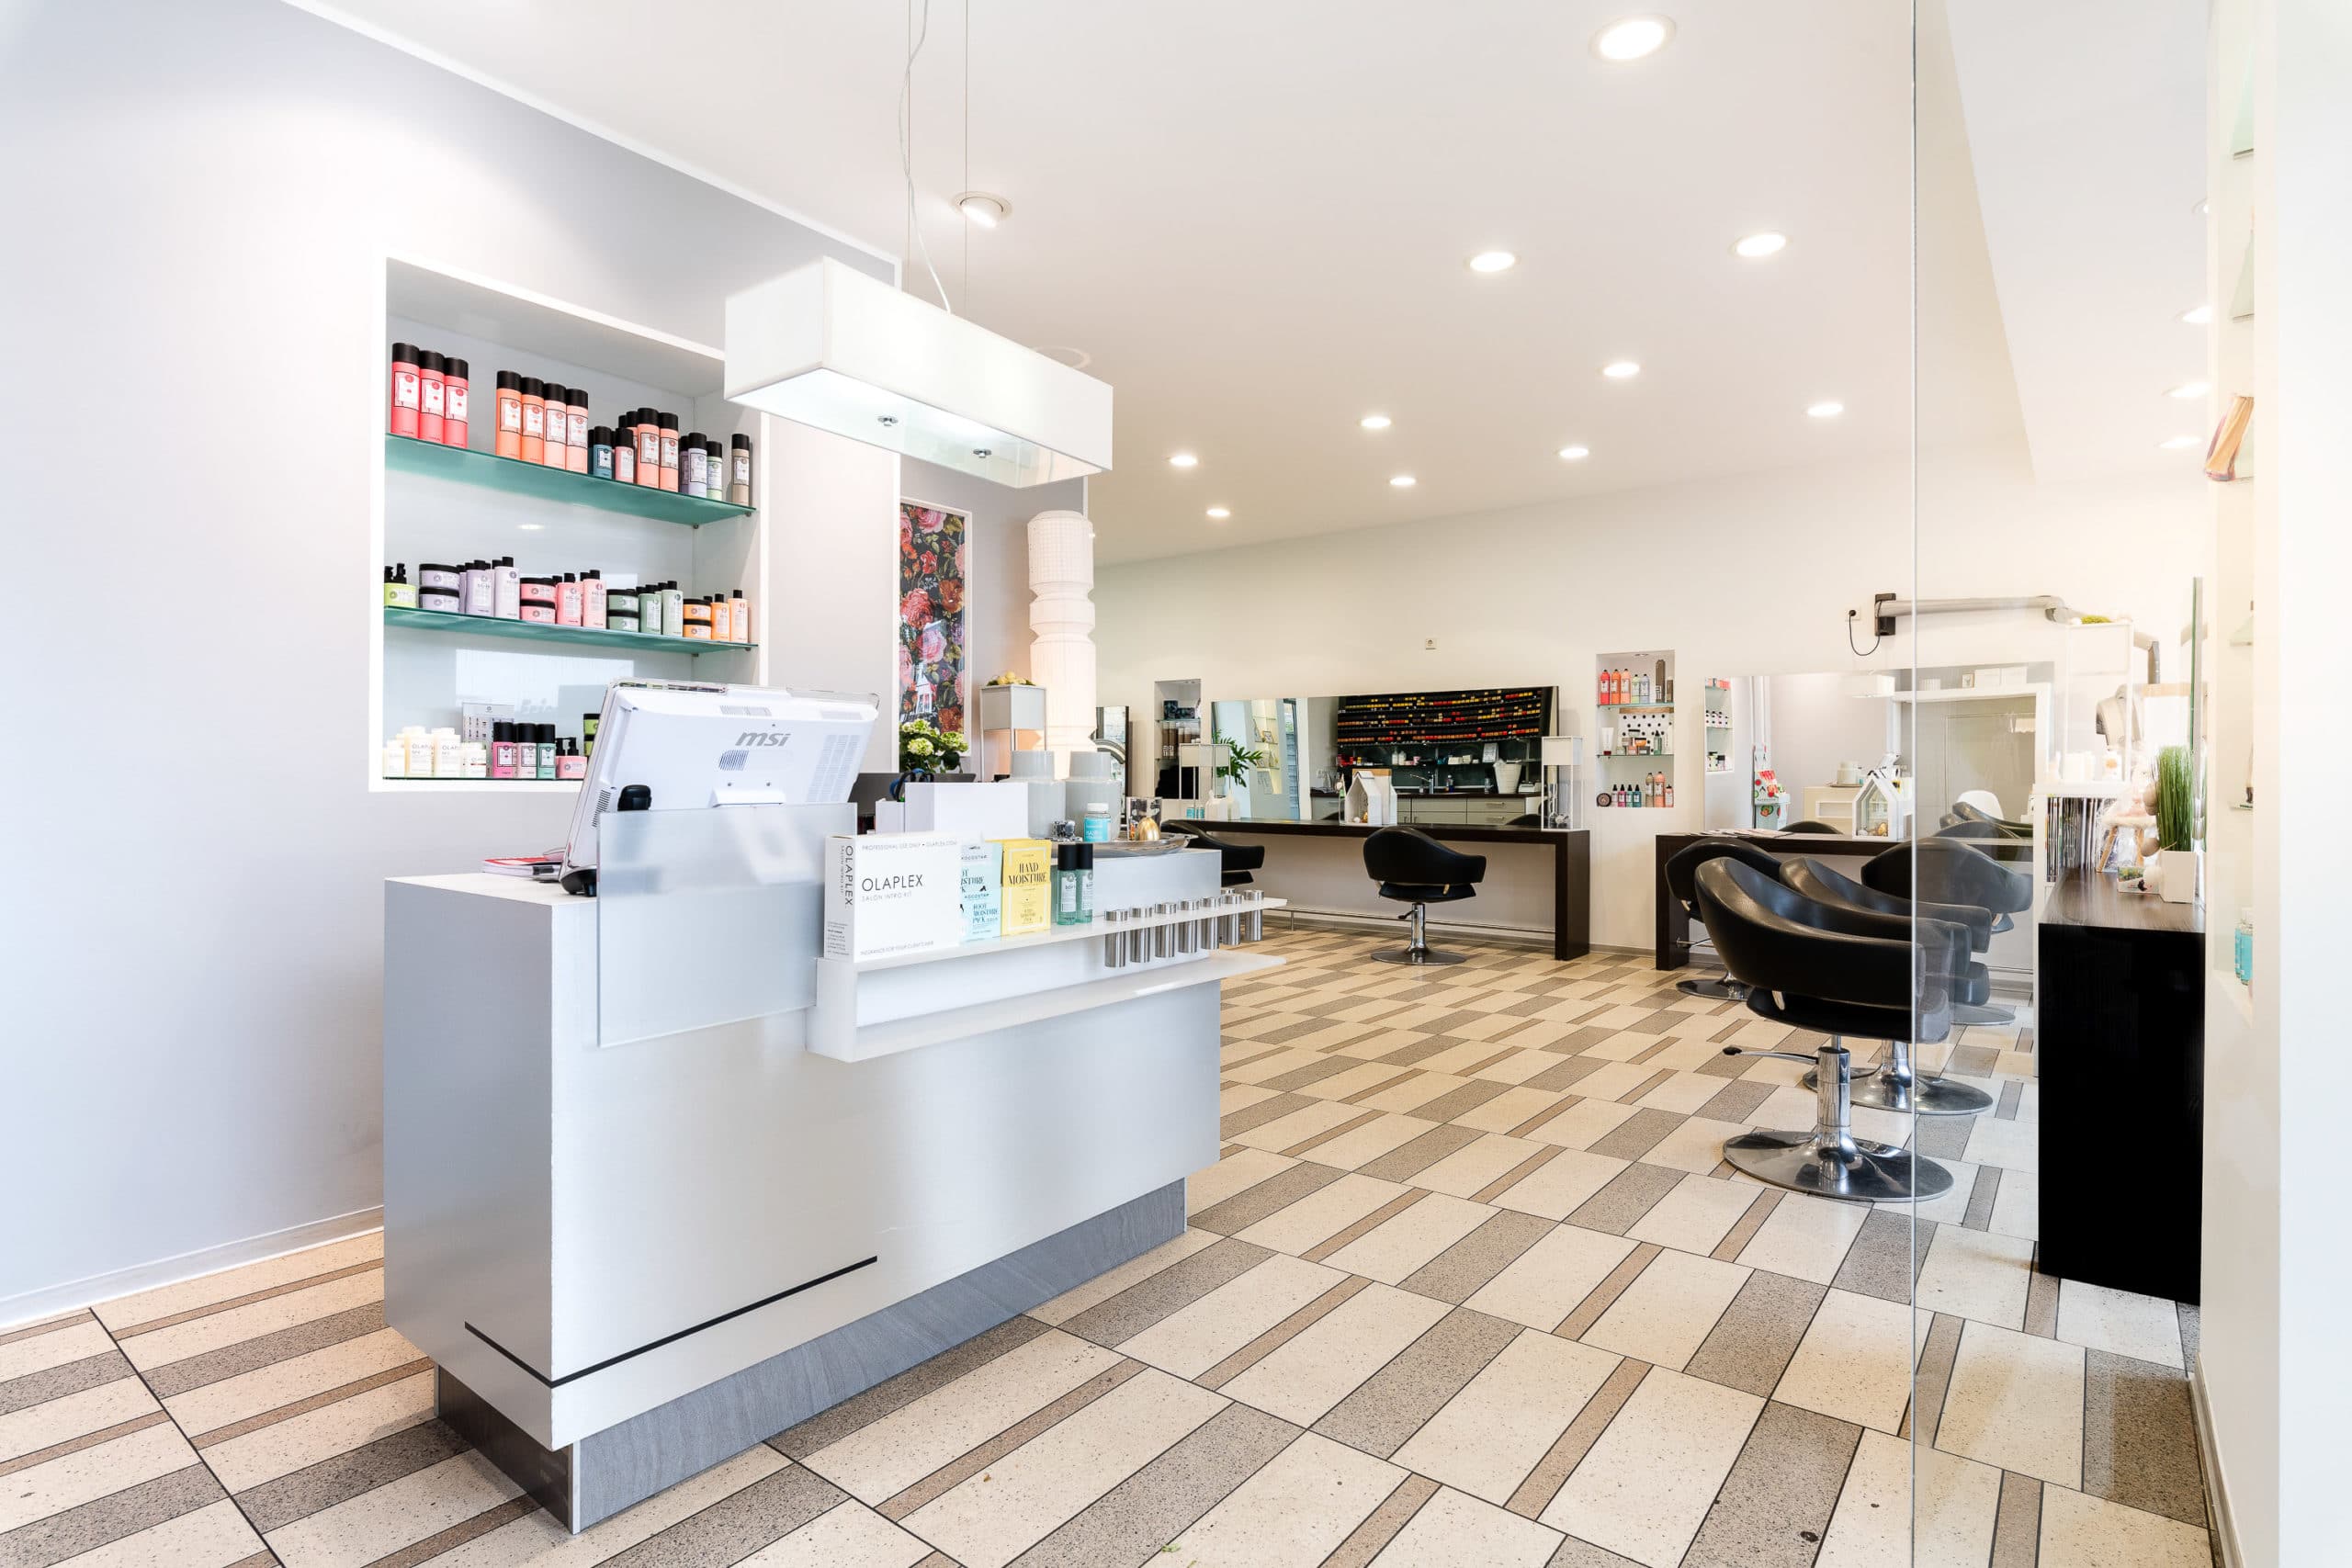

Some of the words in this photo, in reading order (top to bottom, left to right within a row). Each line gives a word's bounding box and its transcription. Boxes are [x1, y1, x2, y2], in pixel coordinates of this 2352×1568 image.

[735, 731, 791, 746] msi
[845, 845, 854, 906] OLAPLEX
[1019, 862, 1039, 874] HAND
[862, 874, 923, 892] OLAPLEX
[1008, 872, 1046, 886] MOISTURE
